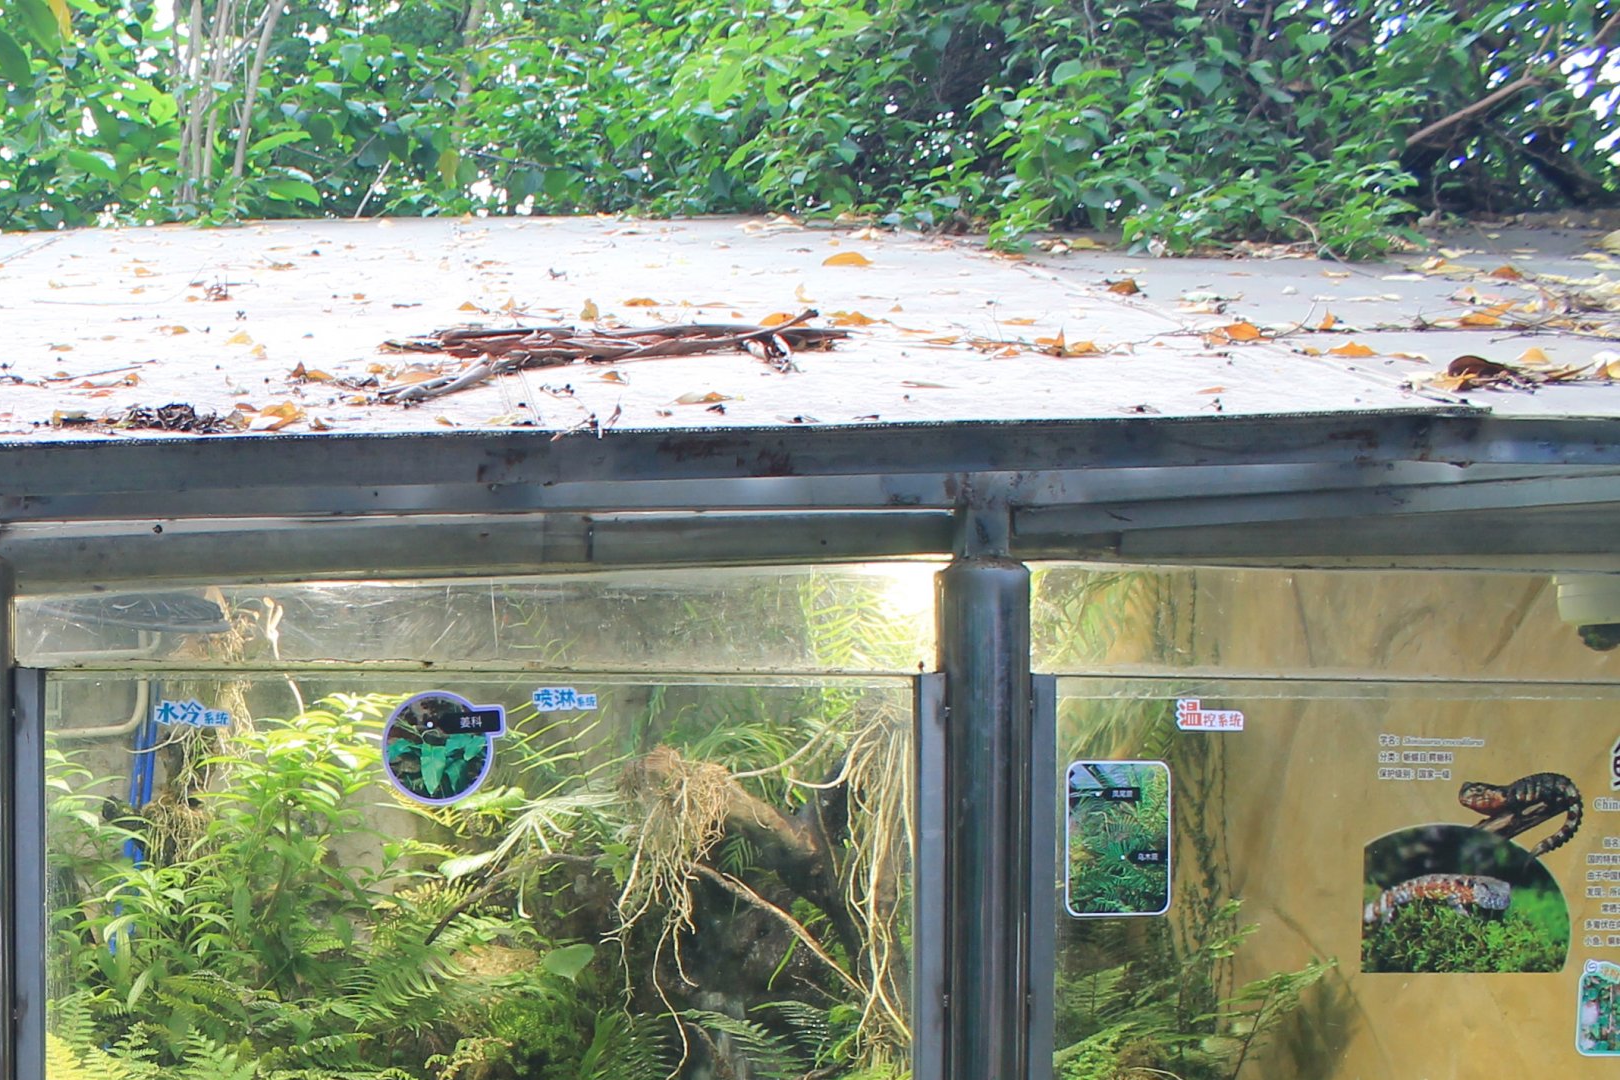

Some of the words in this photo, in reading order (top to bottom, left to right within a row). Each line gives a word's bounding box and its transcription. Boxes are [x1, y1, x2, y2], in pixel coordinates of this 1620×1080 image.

[156, 702, 228, 725] 水冷系统
[1180, 702, 1242, 728] 温控系统
[1594, 799, 1620, 810] Chin
